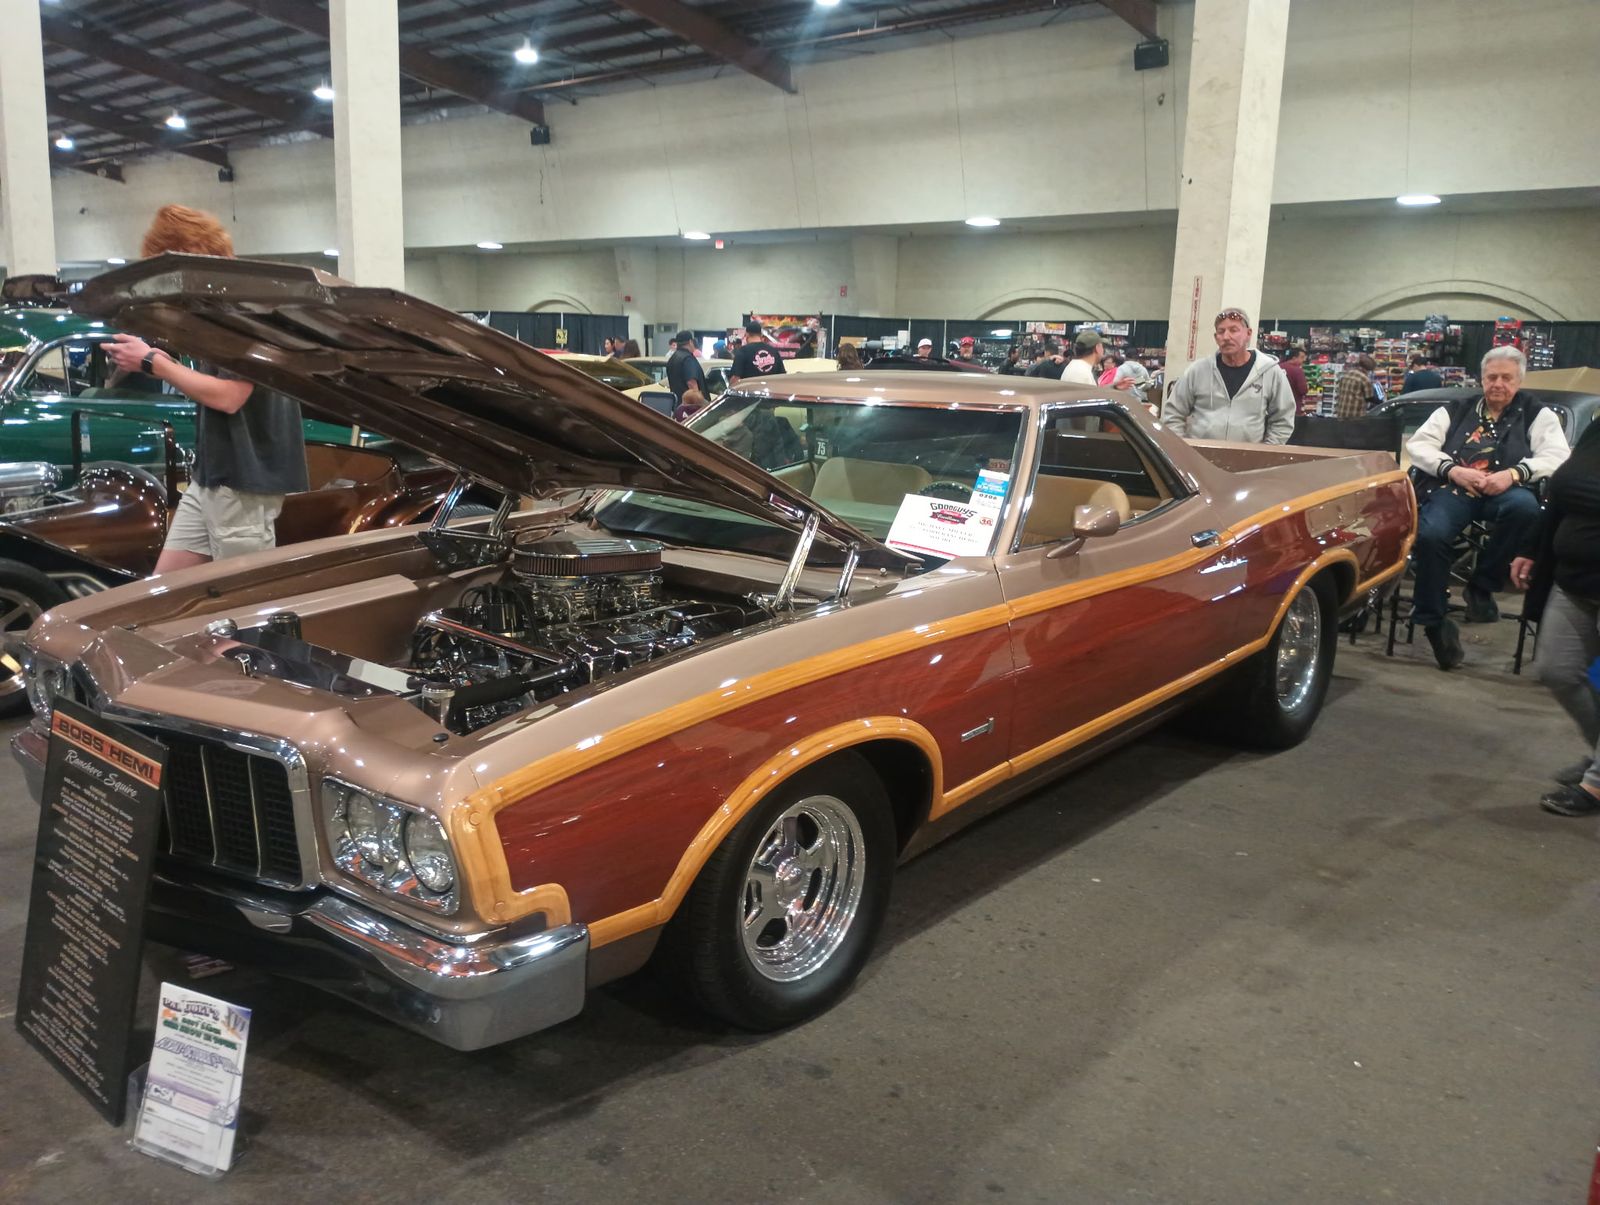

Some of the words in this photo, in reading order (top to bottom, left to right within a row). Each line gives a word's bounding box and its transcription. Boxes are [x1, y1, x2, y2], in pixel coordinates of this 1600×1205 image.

[817, 441, 826, 456] 75
[930, 502, 977, 518] GOODGUYS
[60, 719, 103, 752] BOSS
[109, 745, 153, 779] HEMI
[104, 773, 138, 798] Squire
